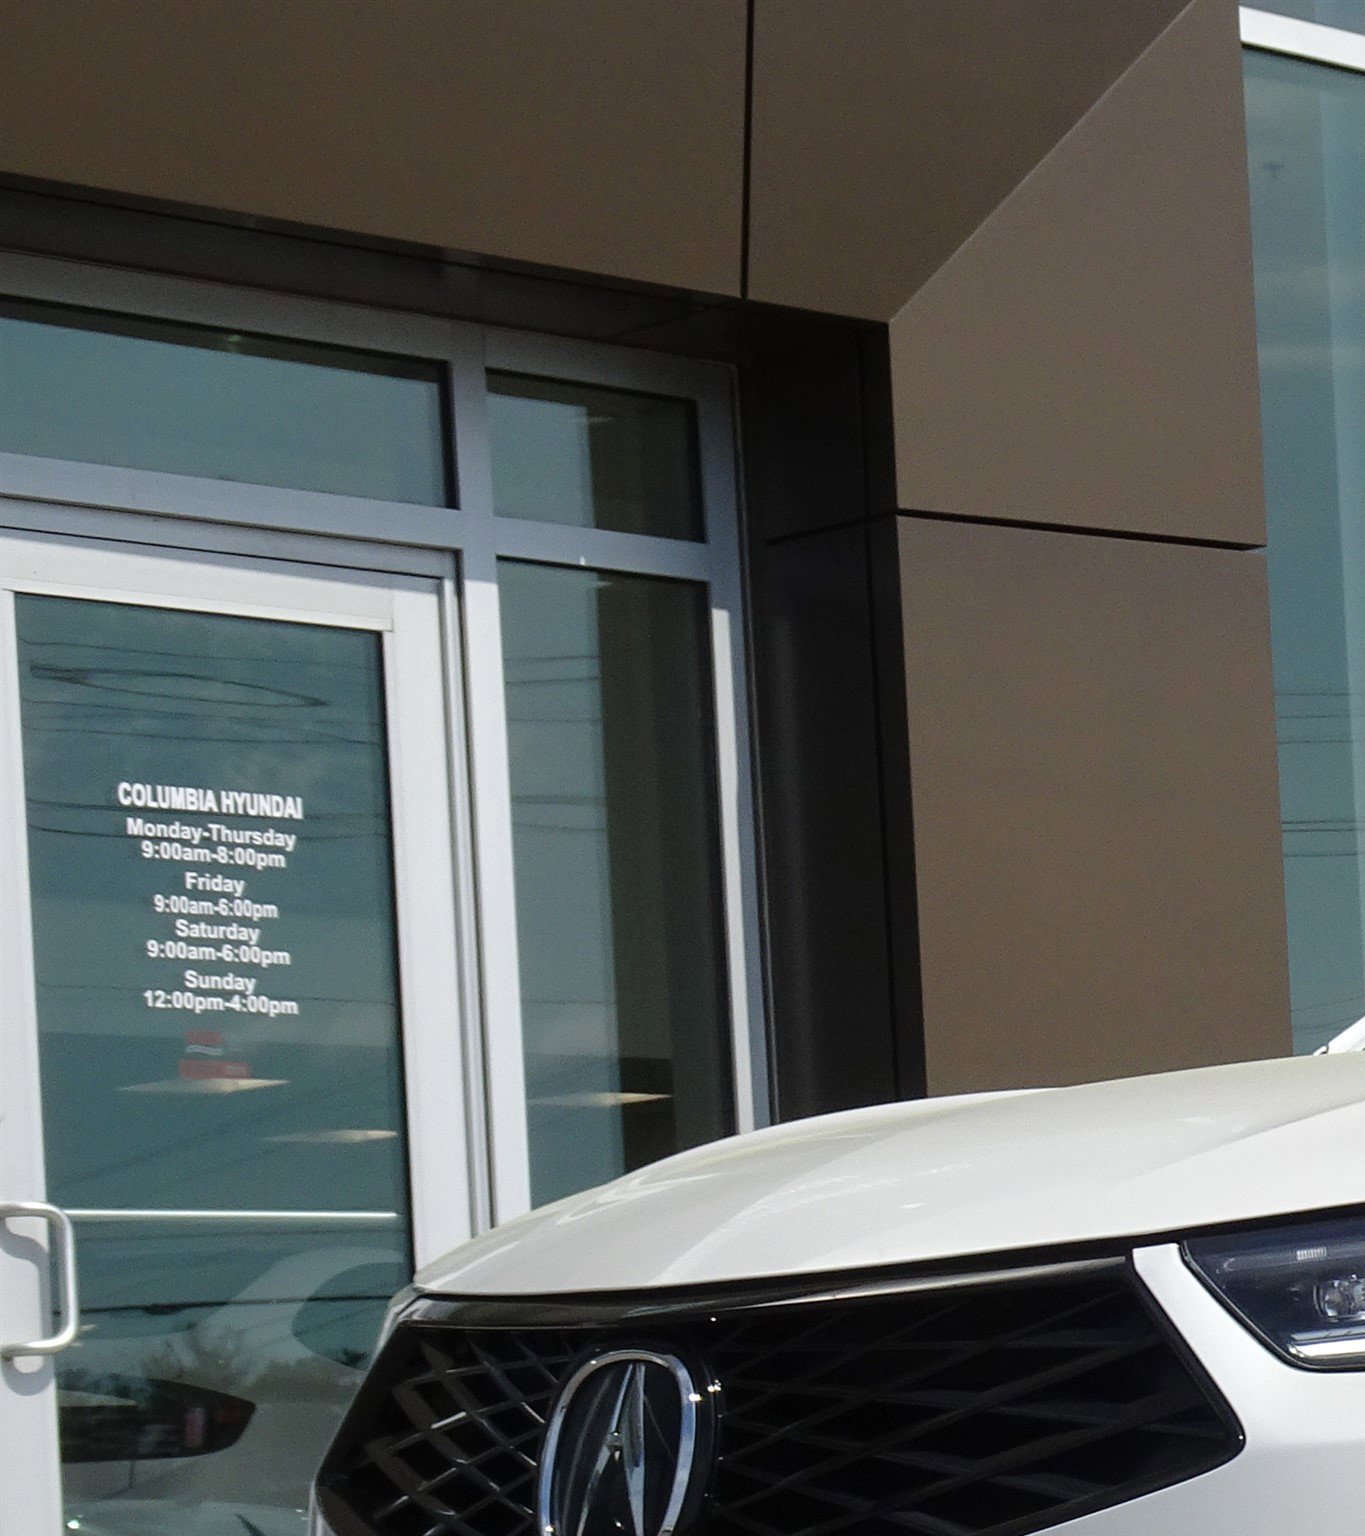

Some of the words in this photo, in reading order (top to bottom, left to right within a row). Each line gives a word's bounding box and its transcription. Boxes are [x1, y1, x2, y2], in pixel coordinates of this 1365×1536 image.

[117, 782, 219, 813] COLUMBIA
[220, 790, 304, 820] HYUNDAI
[126, 817, 297, 852] Monday-Thursday
[141, 840, 287, 870] 9:00am-8:00pm
[184, 871, 246, 897] Friday
[153, 894, 279, 921] 9:00am-6:00pm
[174, 919, 262, 945] Saturday
[146, 940, 291, 968] 9:00am-6:00pm
[184, 969, 257, 995] Sunday
[143, 990, 300, 1018] 12:00pm-4:00pm
